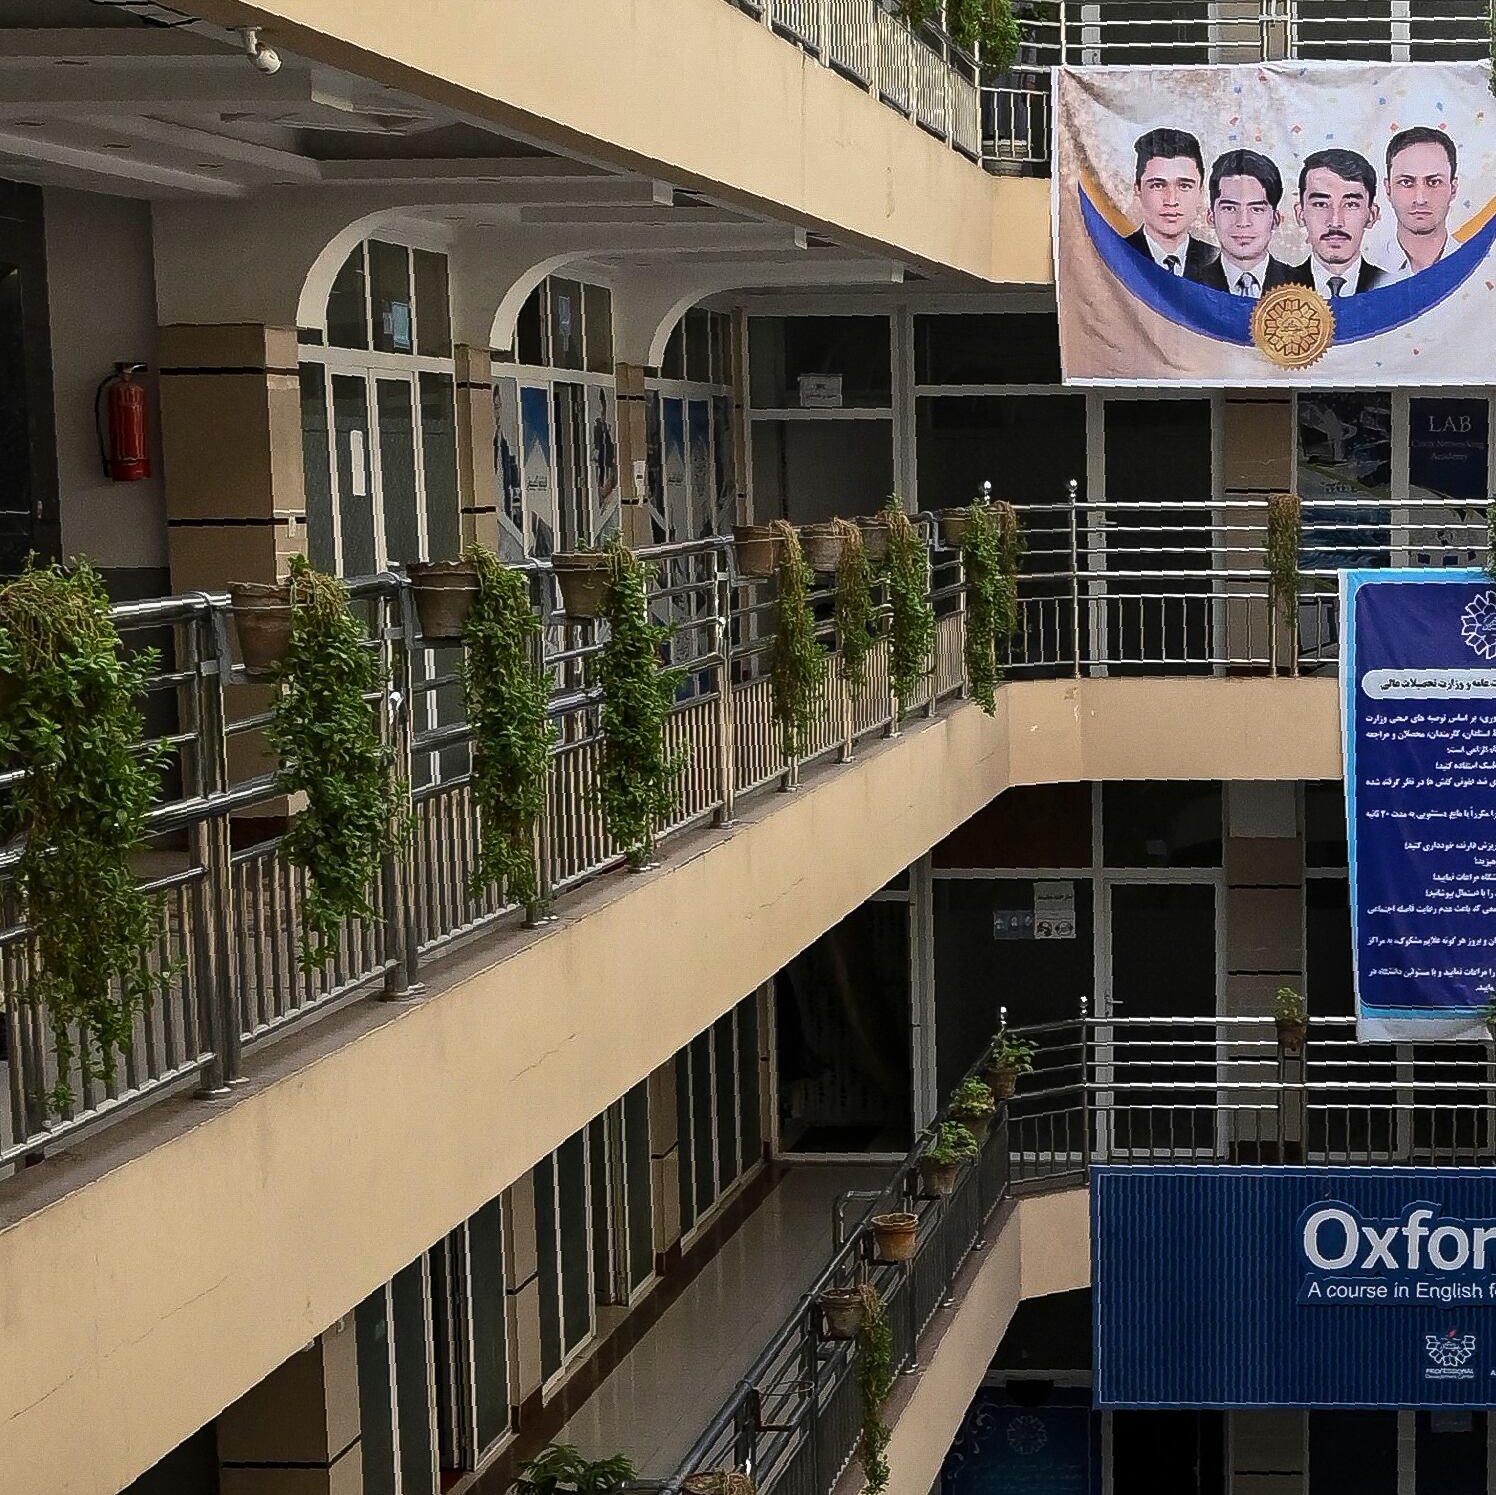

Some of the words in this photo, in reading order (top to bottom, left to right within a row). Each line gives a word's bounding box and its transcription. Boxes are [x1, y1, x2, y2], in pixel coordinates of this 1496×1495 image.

[1430, 416, 1471, 432] LAB
[1308, 1282, 1321, 1297] A
[1327, 1286, 1387, 1298] course
[1394, 1282, 1409, 1297] in
[1417, 1282, 1483, 1301] English
